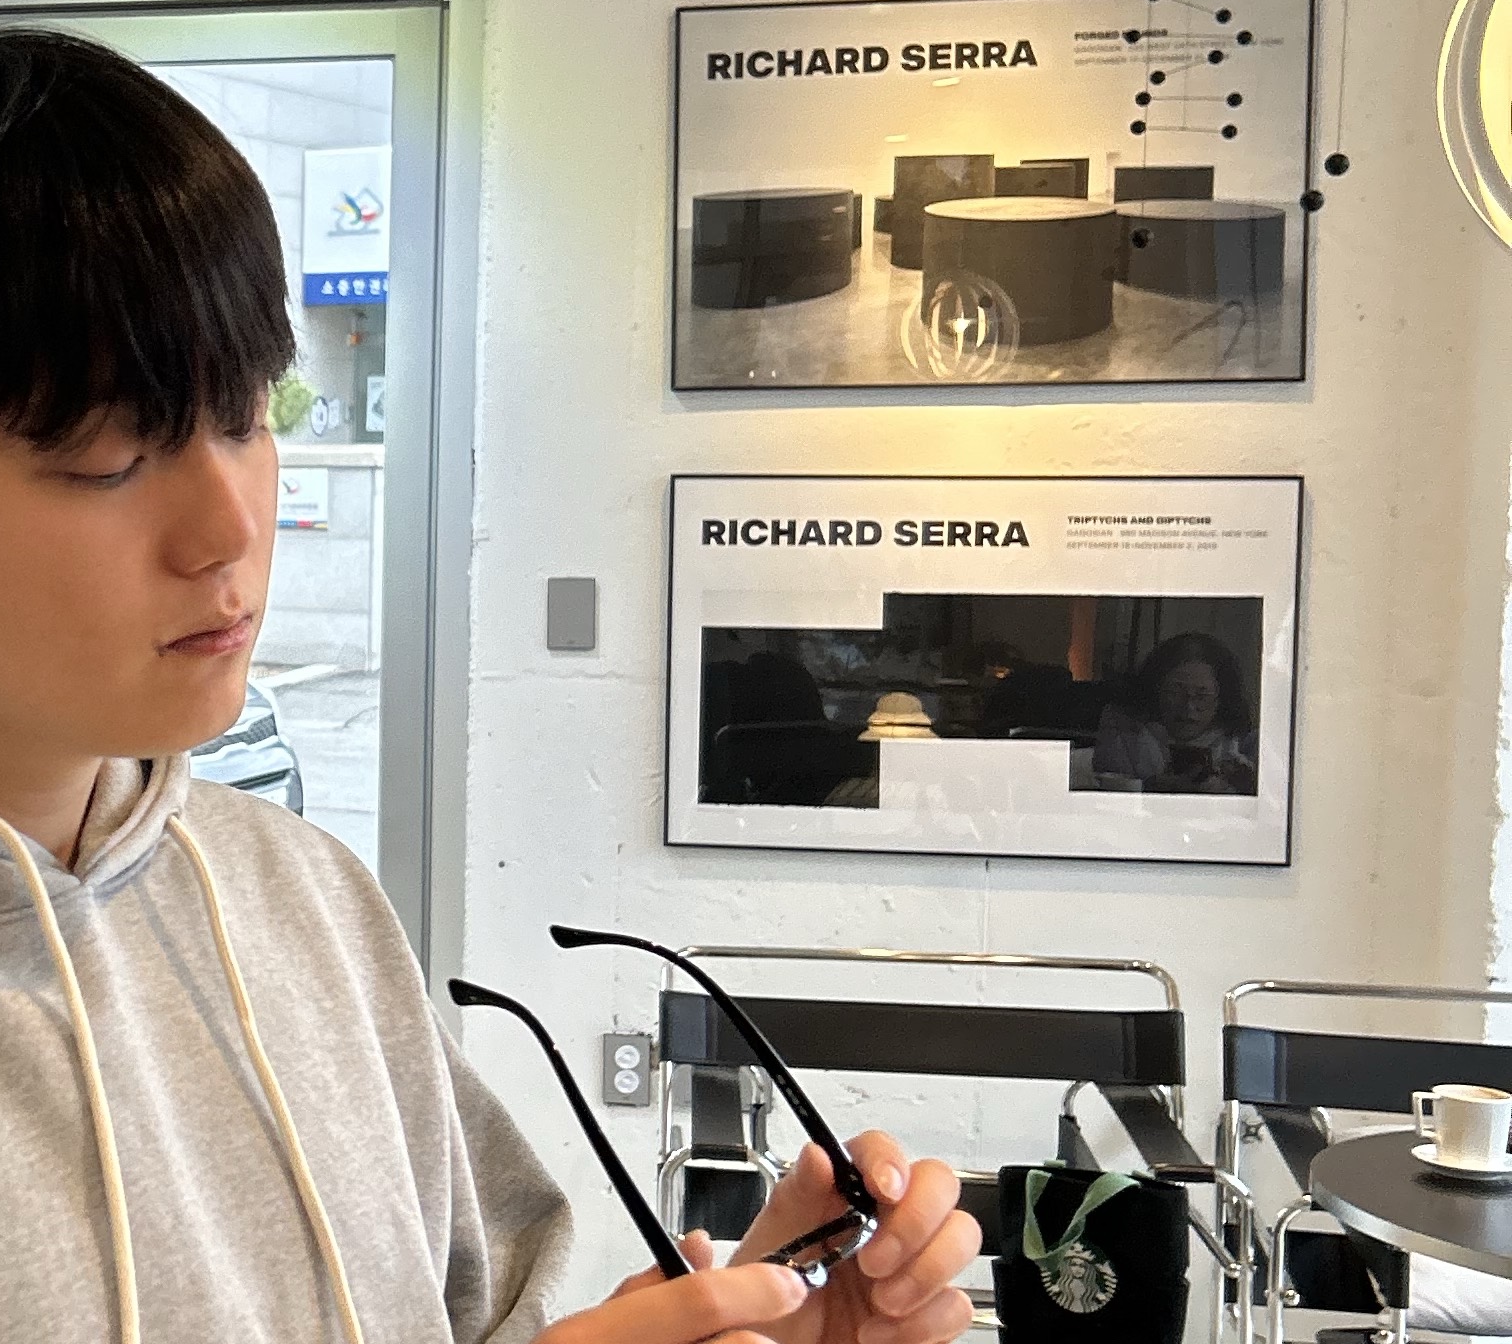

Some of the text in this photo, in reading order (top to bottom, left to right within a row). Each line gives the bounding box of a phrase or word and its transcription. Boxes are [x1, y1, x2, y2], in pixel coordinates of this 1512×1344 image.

[707, 40, 1038, 80] RICHARD SERRA
[702, 519, 1030, 547] RICHARD SERRA
